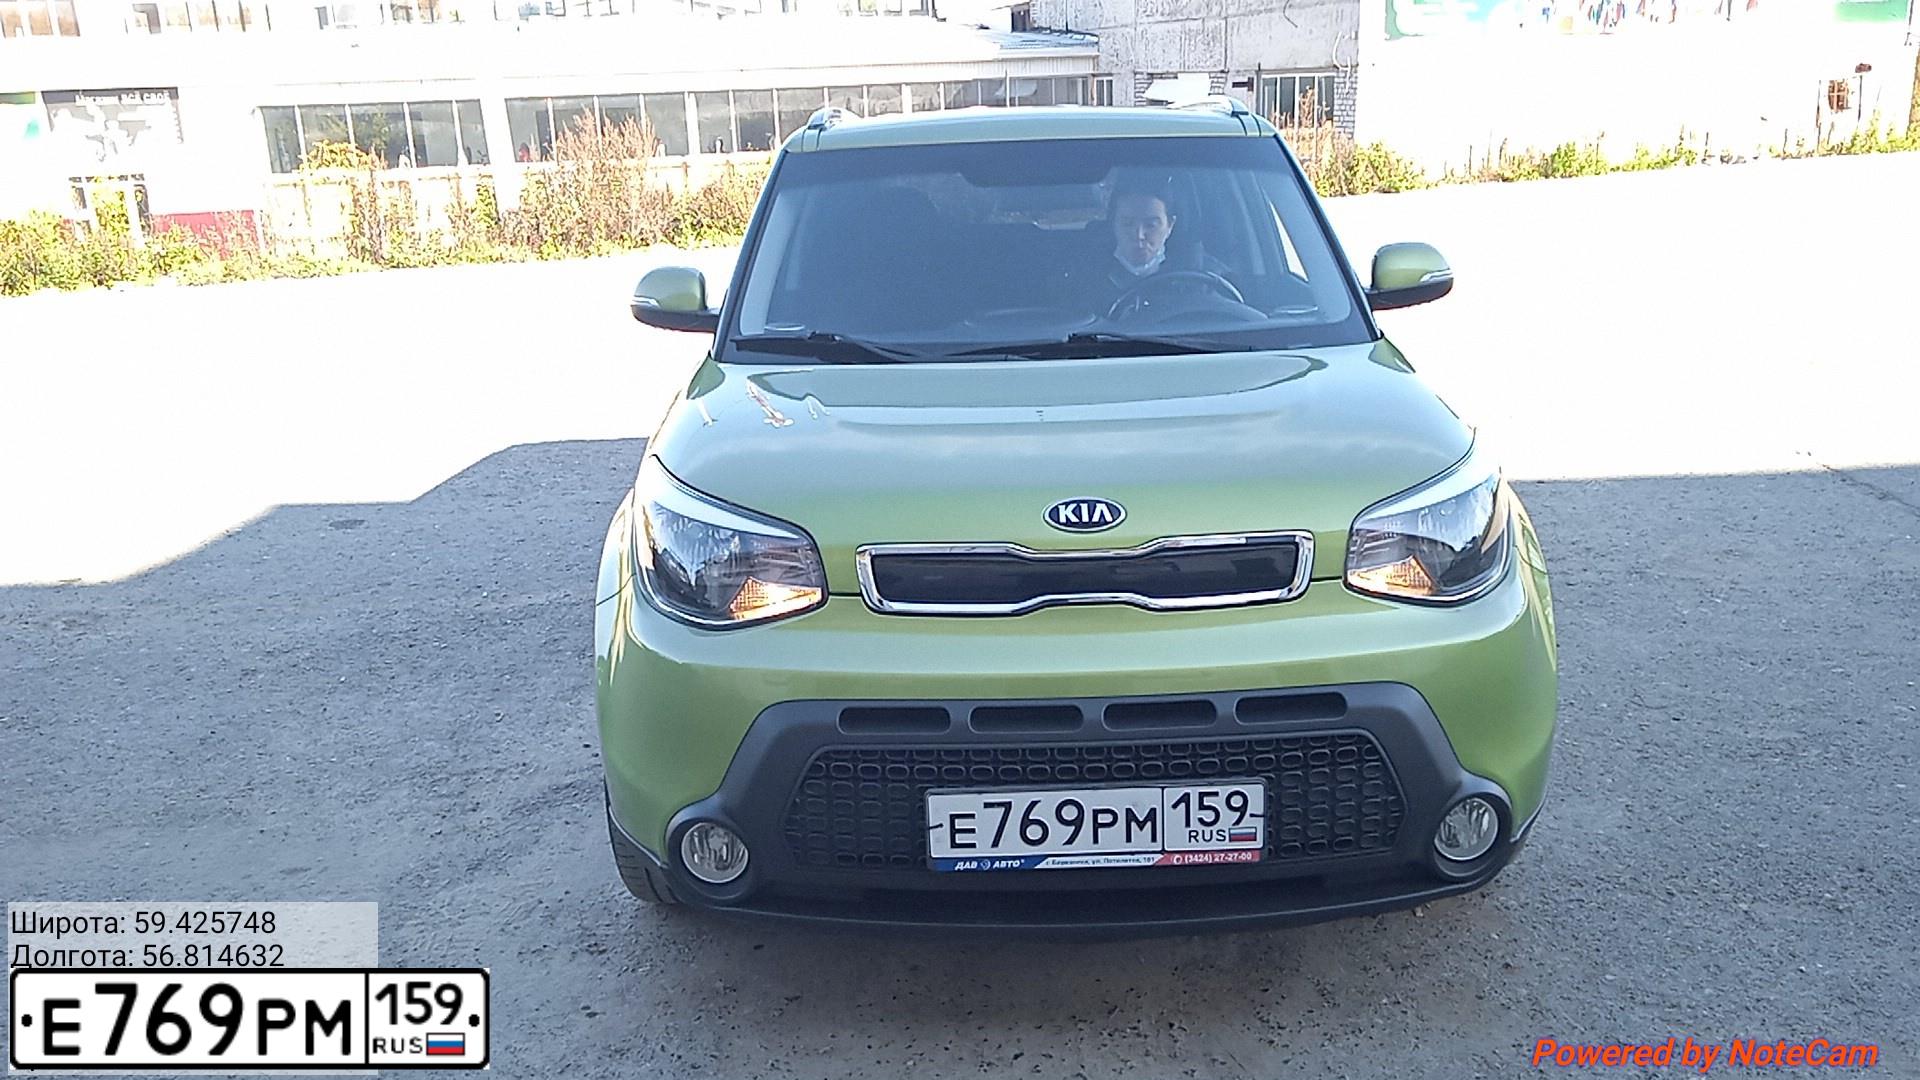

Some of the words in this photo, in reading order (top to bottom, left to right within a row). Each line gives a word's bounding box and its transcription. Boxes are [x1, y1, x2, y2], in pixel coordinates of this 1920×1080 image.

[1057, 502, 1114, 523] KIA
[1171, 789, 1250, 829] 159
[1188, 828, 1227, 844] RUS
[1184, 853, 1213, 864] (3424)
[1214, 851, 1252, 862] 27-27-00
